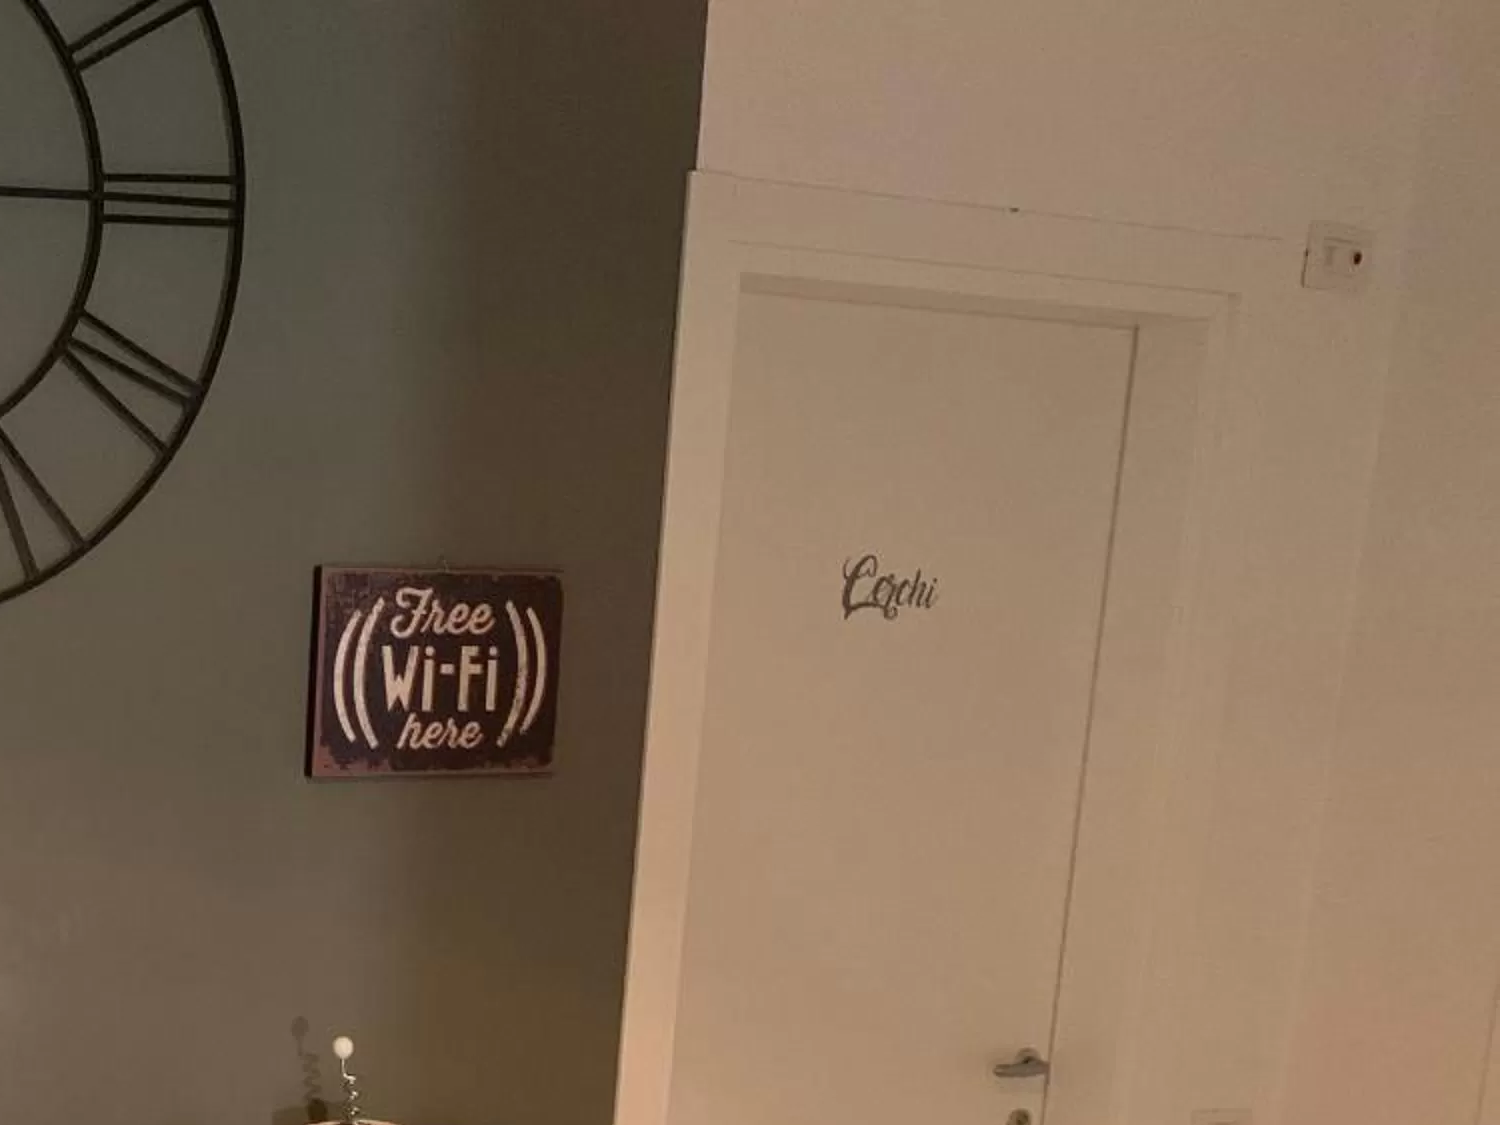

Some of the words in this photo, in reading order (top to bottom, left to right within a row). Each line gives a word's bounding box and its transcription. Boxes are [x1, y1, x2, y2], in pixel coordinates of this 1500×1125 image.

[390, 587, 496, 638] Free
[381, 644, 499, 712] Wi-Fi
[397, 712, 484, 749] here
